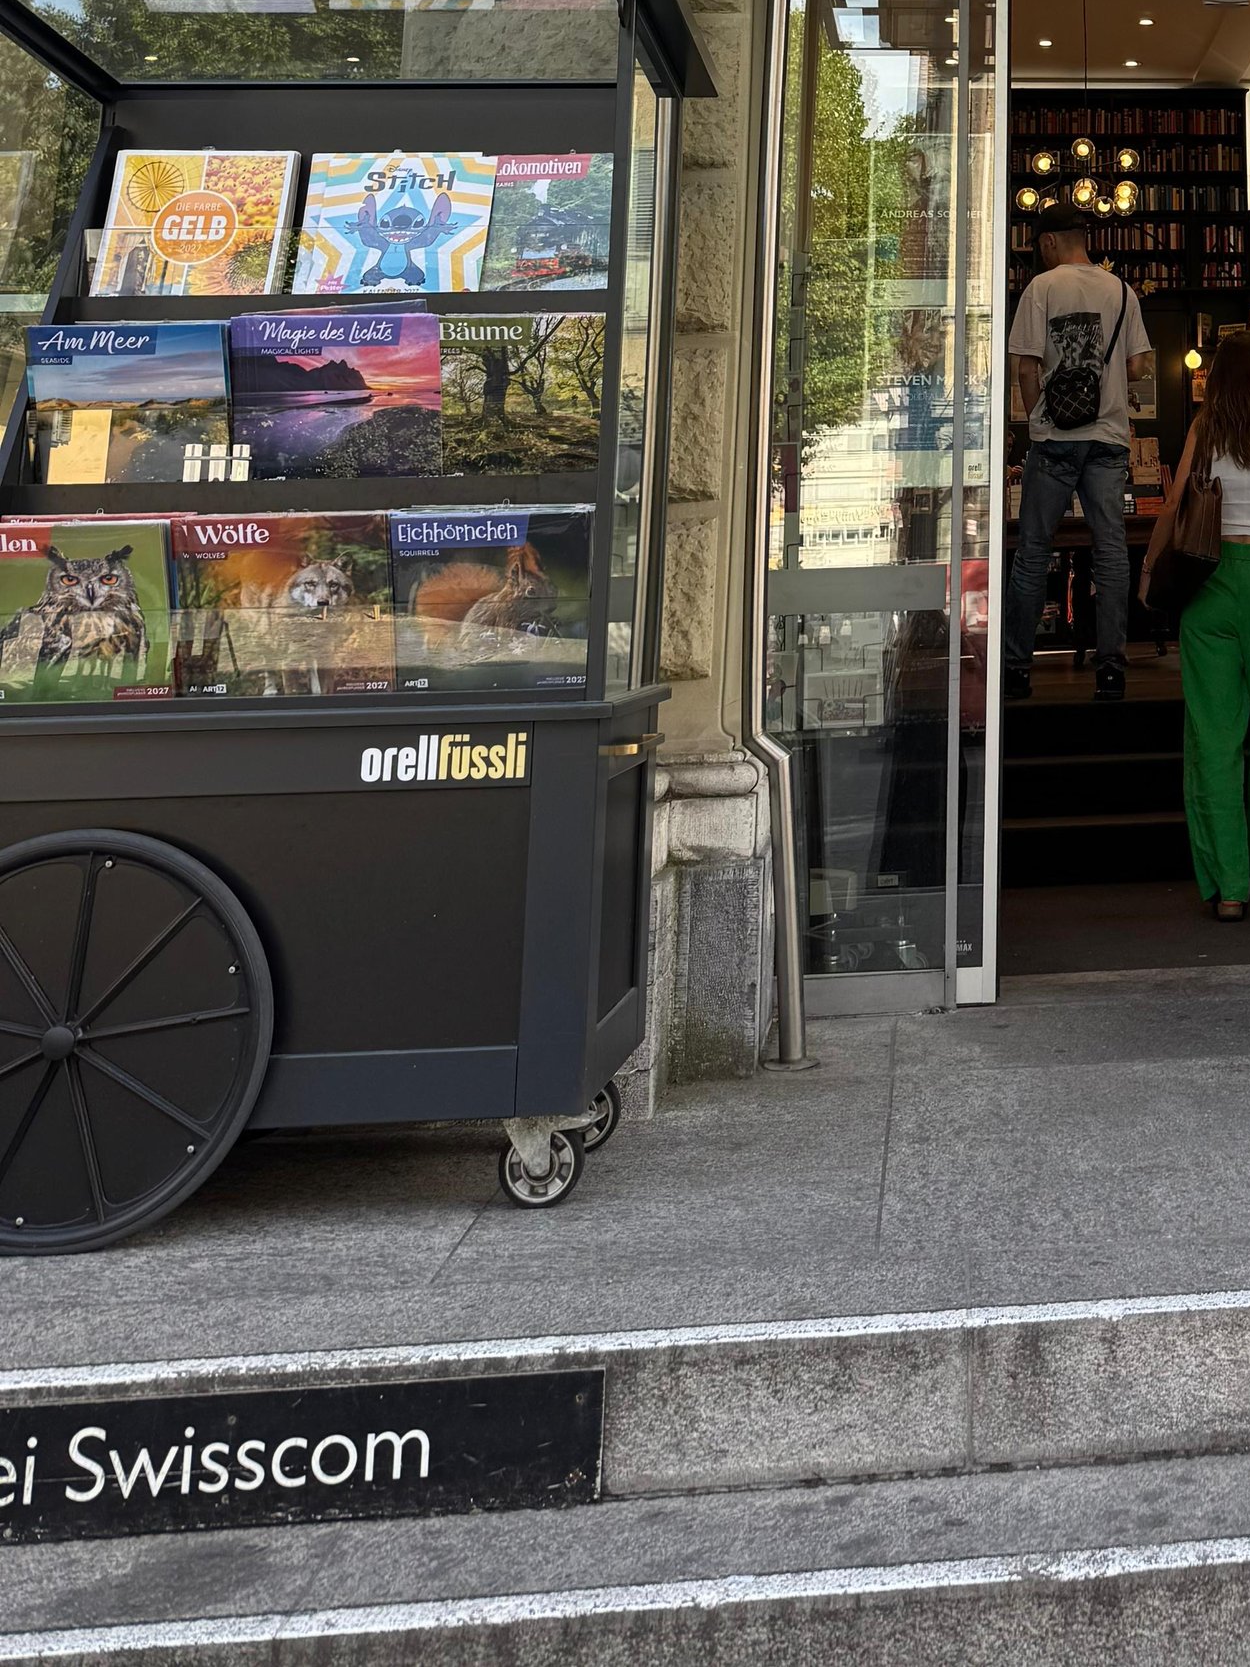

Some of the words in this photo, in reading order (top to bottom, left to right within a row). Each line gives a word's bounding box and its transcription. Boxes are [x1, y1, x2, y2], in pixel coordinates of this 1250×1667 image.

[176, 202, 190, 211] DIE
[194, 202, 221, 211] FARBE
[880, 210, 934, 218] ANDREAS
[162, 215, 227, 241] GELB
[179, 244, 200, 254] 2027
[259, 320, 316, 349] Magie
[319, 326, 345, 341] des
[349, 320, 394, 343] Lichts
[440, 322, 523, 341] Bäume
[38, 331, 86, 351] Am
[90, 331, 150, 354] Meer
[876, 375, 931, 385] STEVEN
[194, 523, 270, 545] Wölfe
[398, 520, 518, 543] Eichhörnchen
[399, 549, 440, 557] SQUIRRELS
[366, 681, 388, 690] 2027
[566, 675, 587, 684] 2027
[147, 687, 169, 696] 2027
[360, 732, 527, 783] orellfüssli
[65, 1426, 431, 1503] Swisscom
